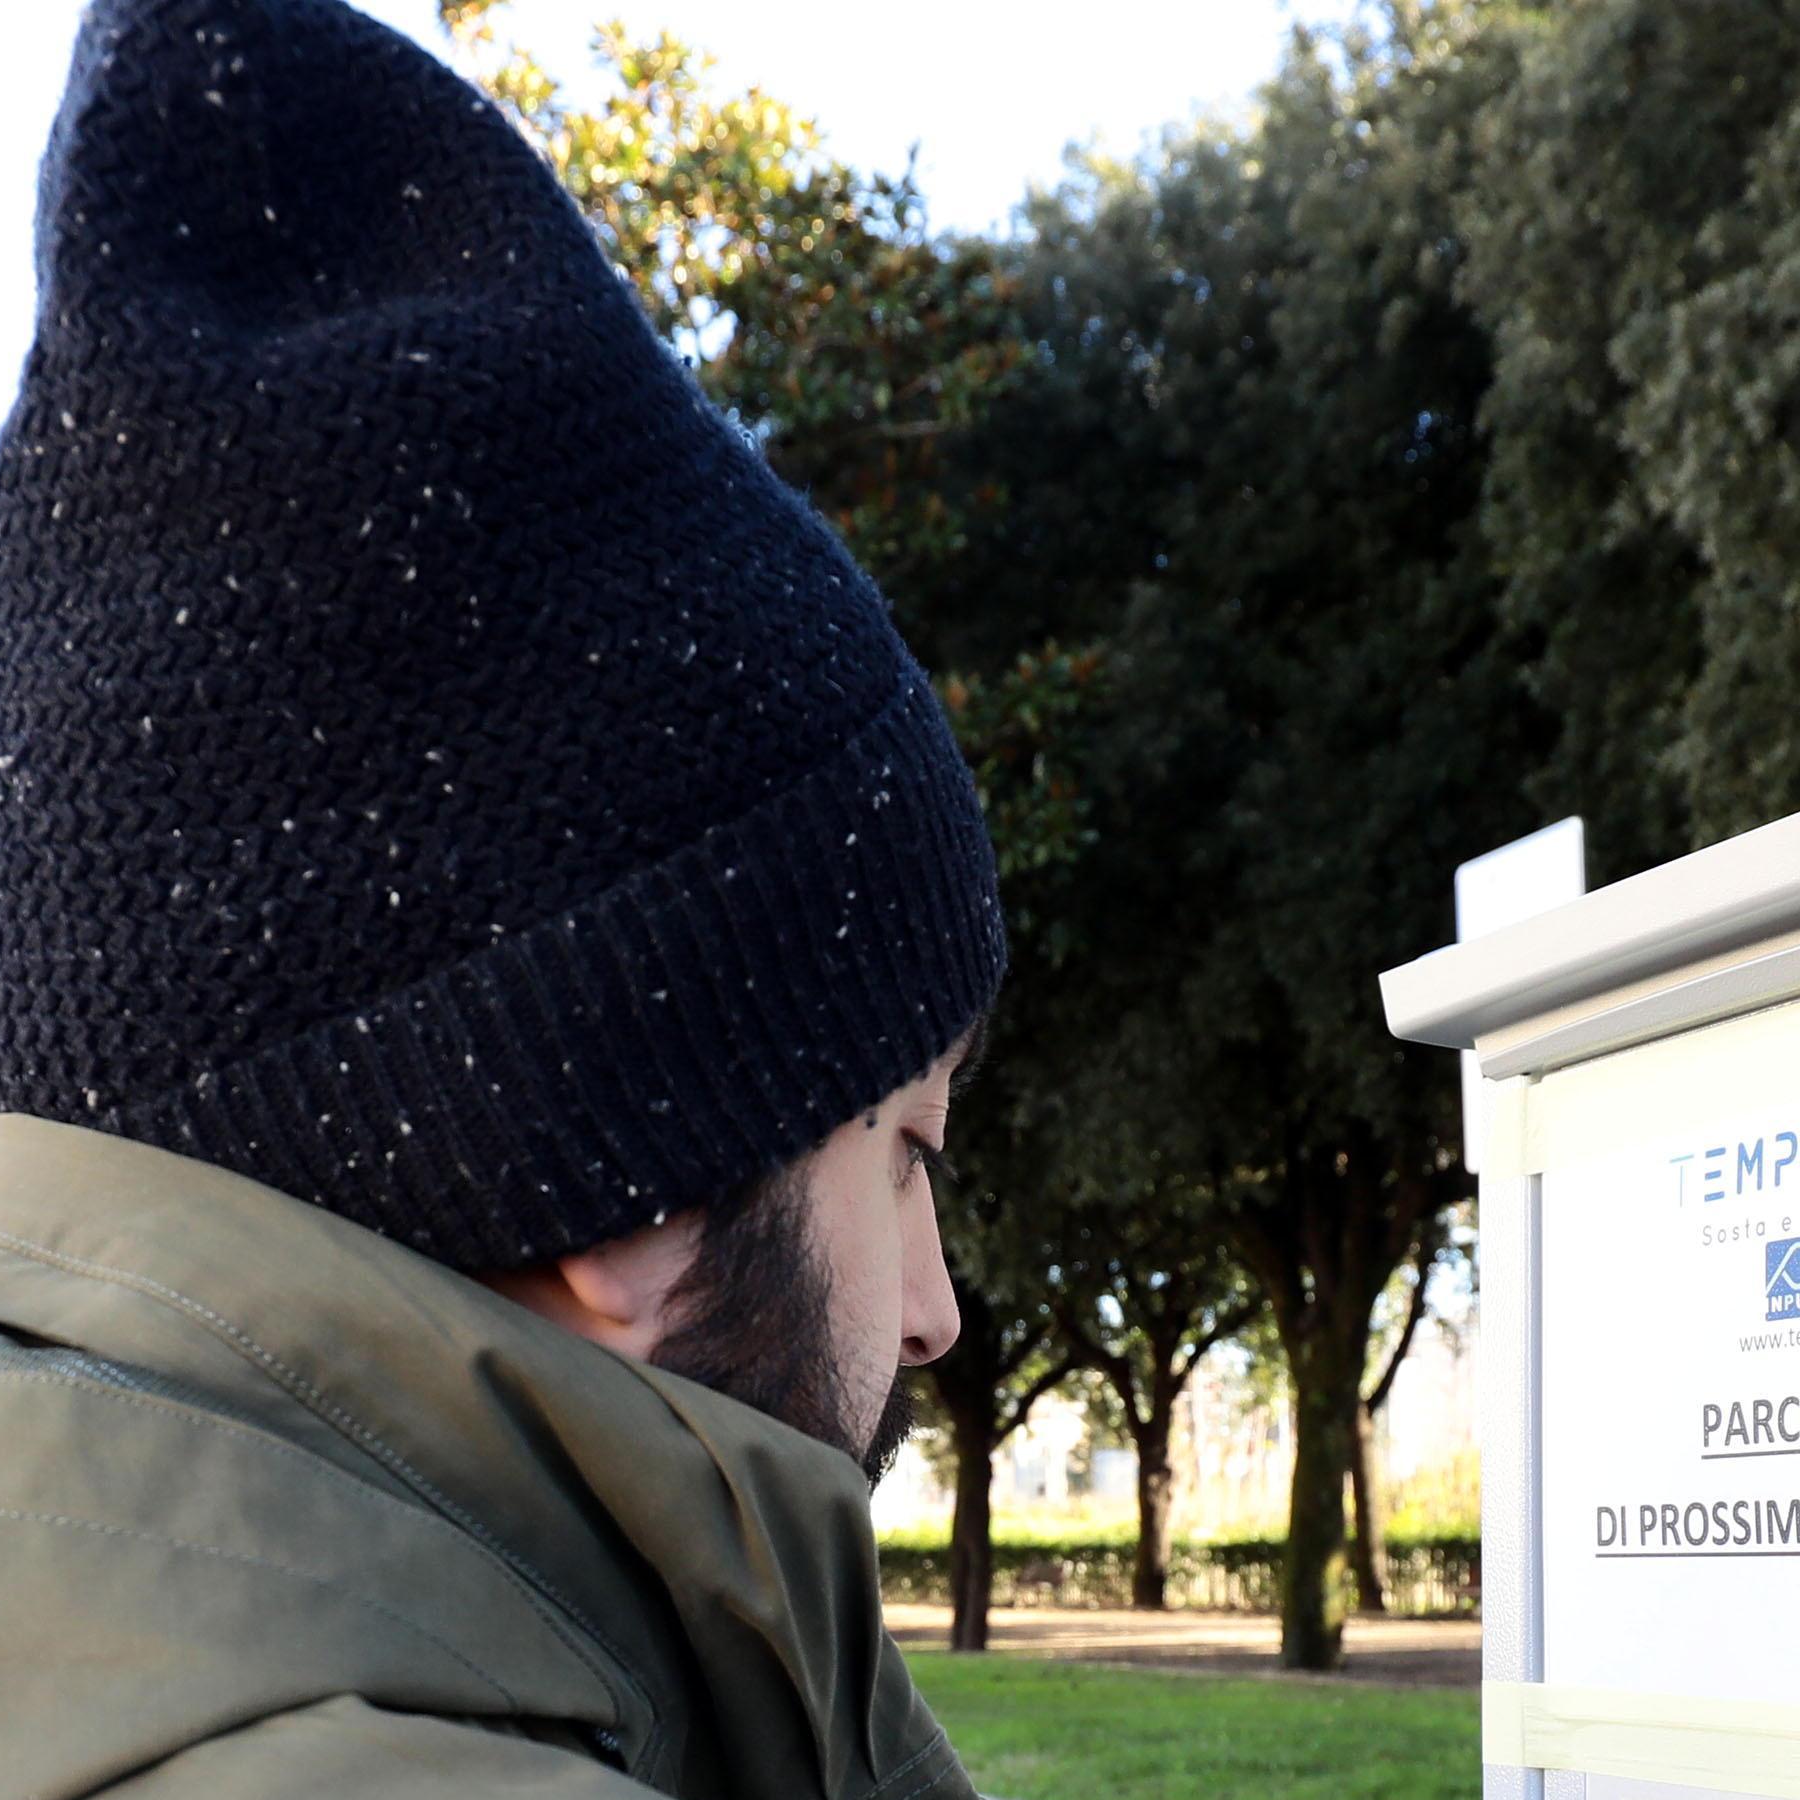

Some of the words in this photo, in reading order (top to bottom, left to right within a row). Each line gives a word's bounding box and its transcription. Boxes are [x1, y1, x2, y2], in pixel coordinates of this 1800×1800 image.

[1702, 1217, 1766, 1246] Sosta
[1781, 1216, 1792, 1232] e
[1597, 1506, 1626, 1547] DI
